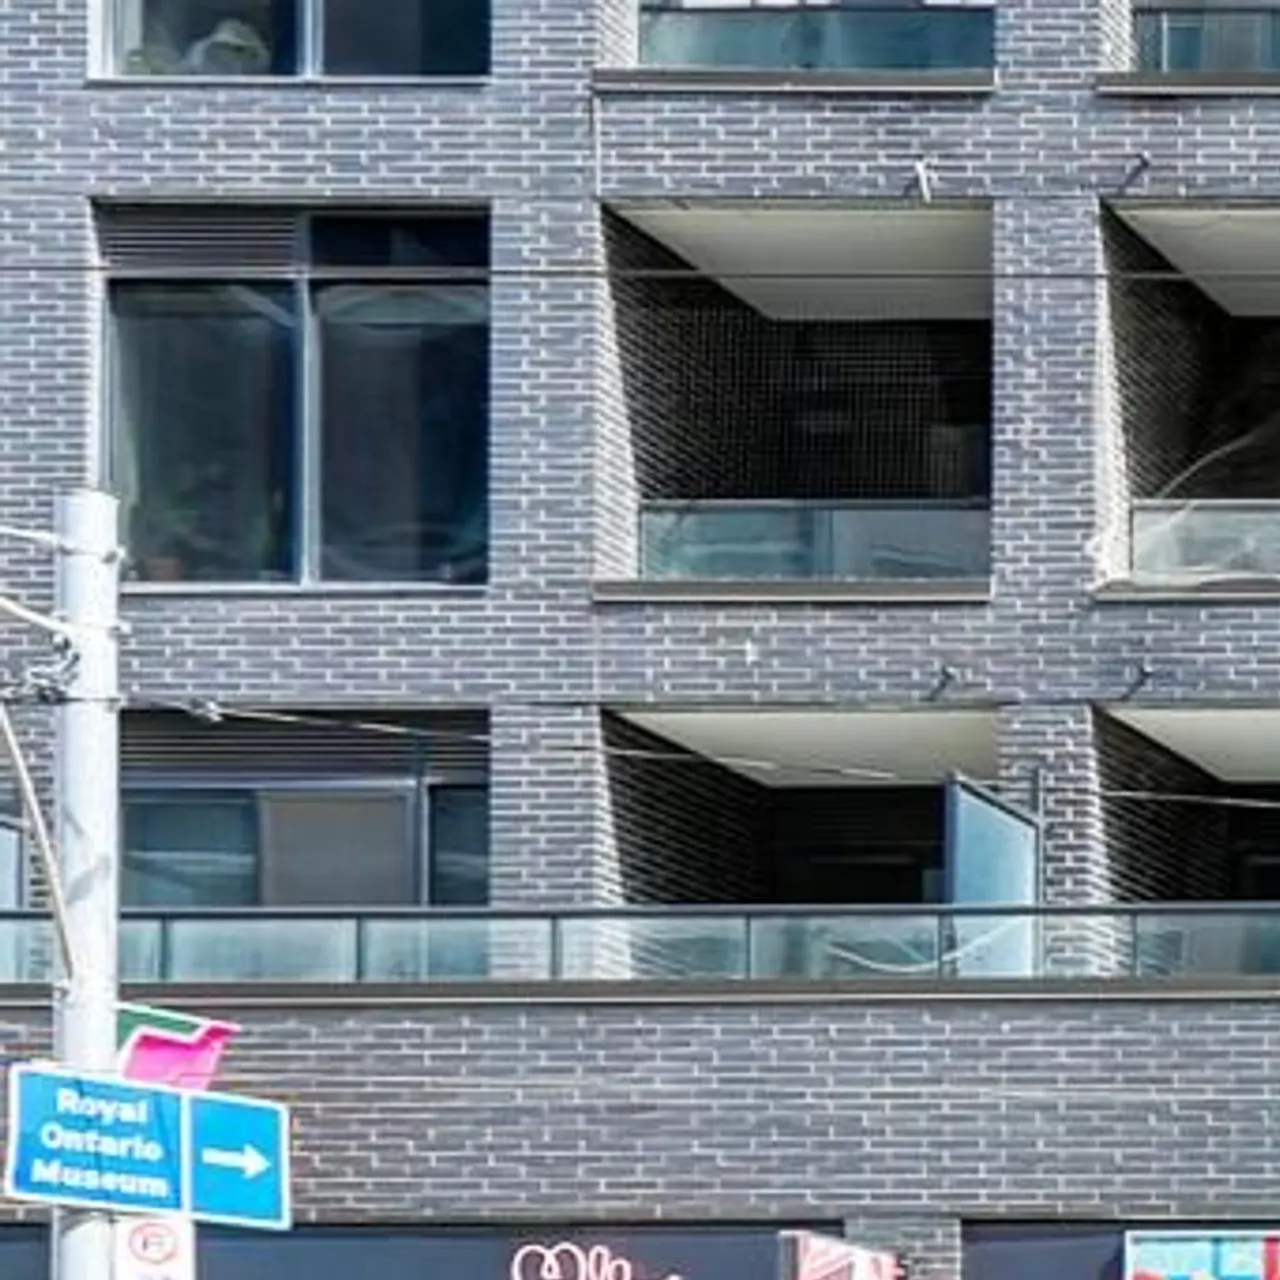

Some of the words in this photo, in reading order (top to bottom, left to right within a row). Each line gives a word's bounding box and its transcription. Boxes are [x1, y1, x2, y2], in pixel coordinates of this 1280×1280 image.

[55, 1087, 148, 1125] Royal
[40, 1121, 164, 1162] Ontario
[30, 1158, 169, 1199] Museum
